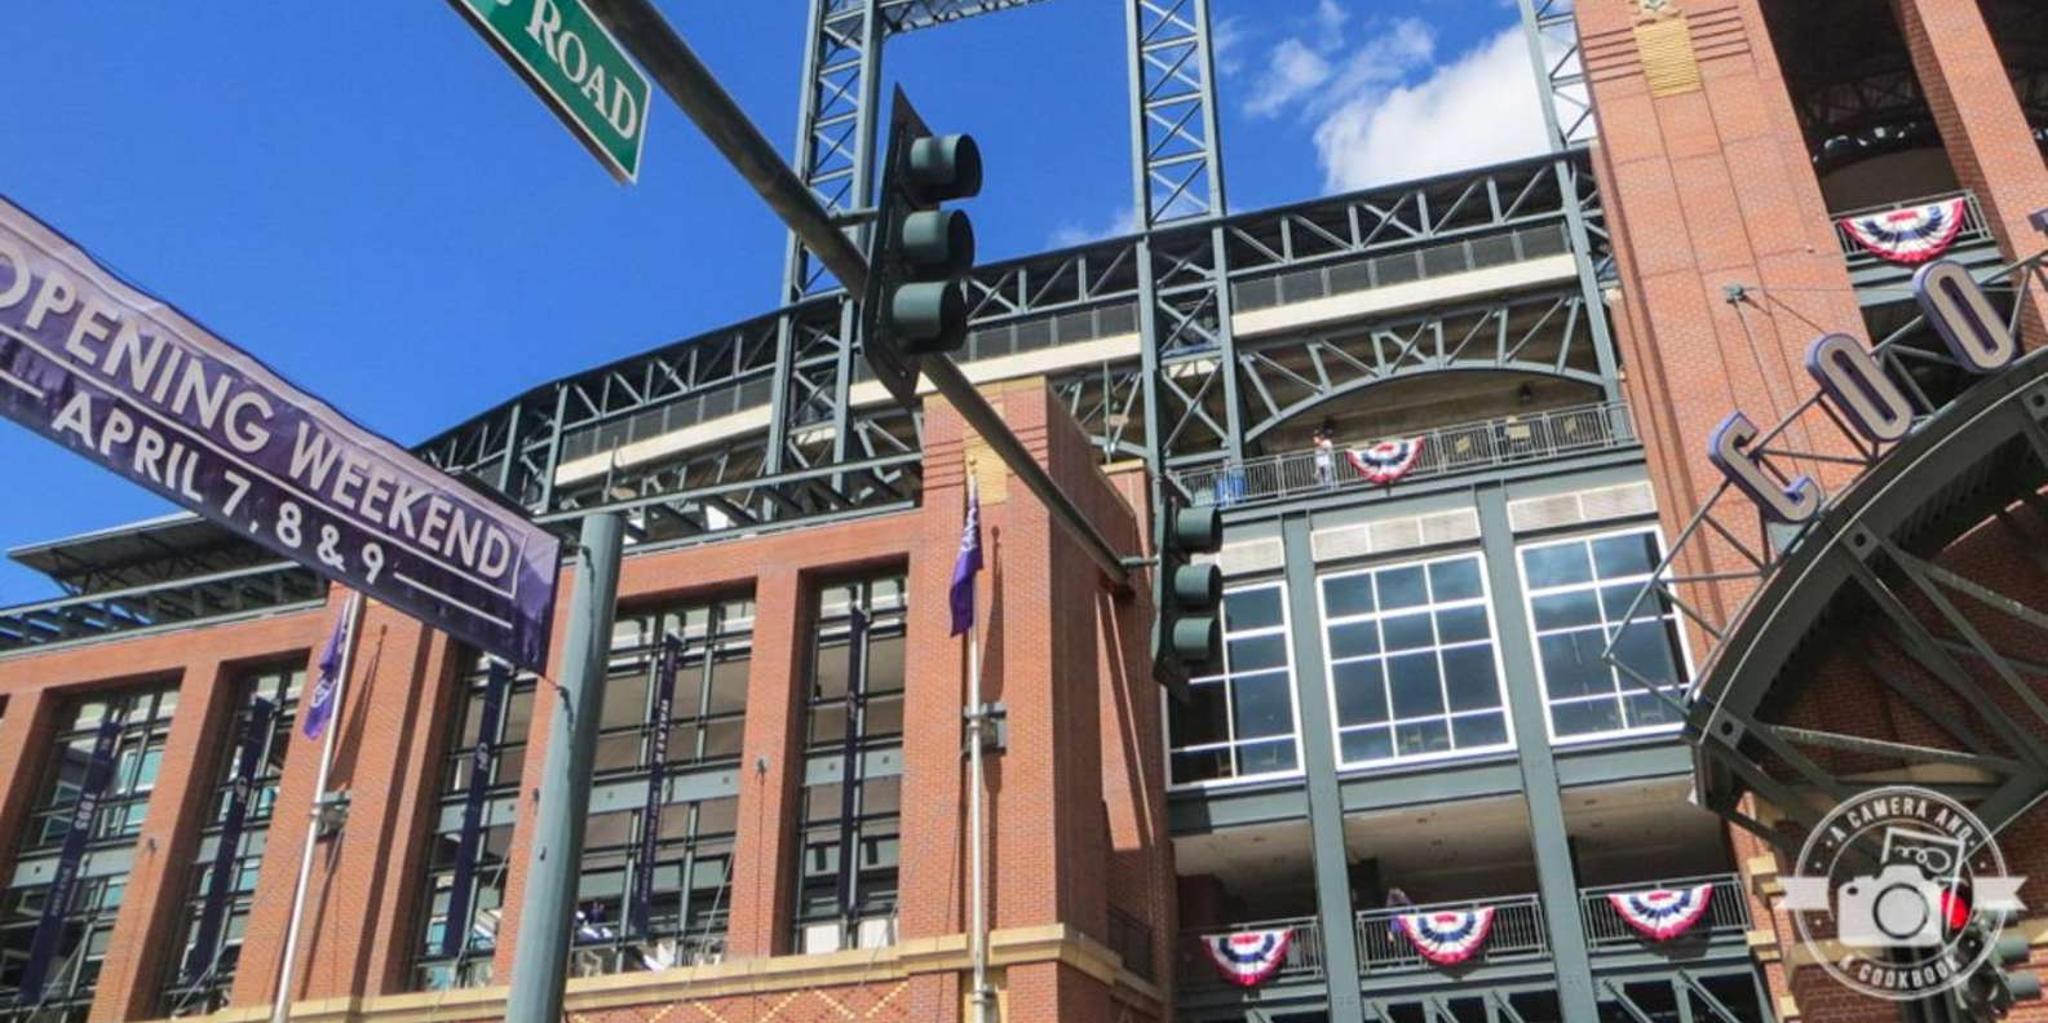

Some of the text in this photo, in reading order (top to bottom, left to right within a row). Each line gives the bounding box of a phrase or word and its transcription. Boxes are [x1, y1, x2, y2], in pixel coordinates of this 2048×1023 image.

[525, 0, 637, 139] ROAD
[0, 247, 512, 580] OPENING WEEKEND
[51, 390, 386, 584] APRIL 7, 8 & 9
[1707, 208, 2048, 523] COO
